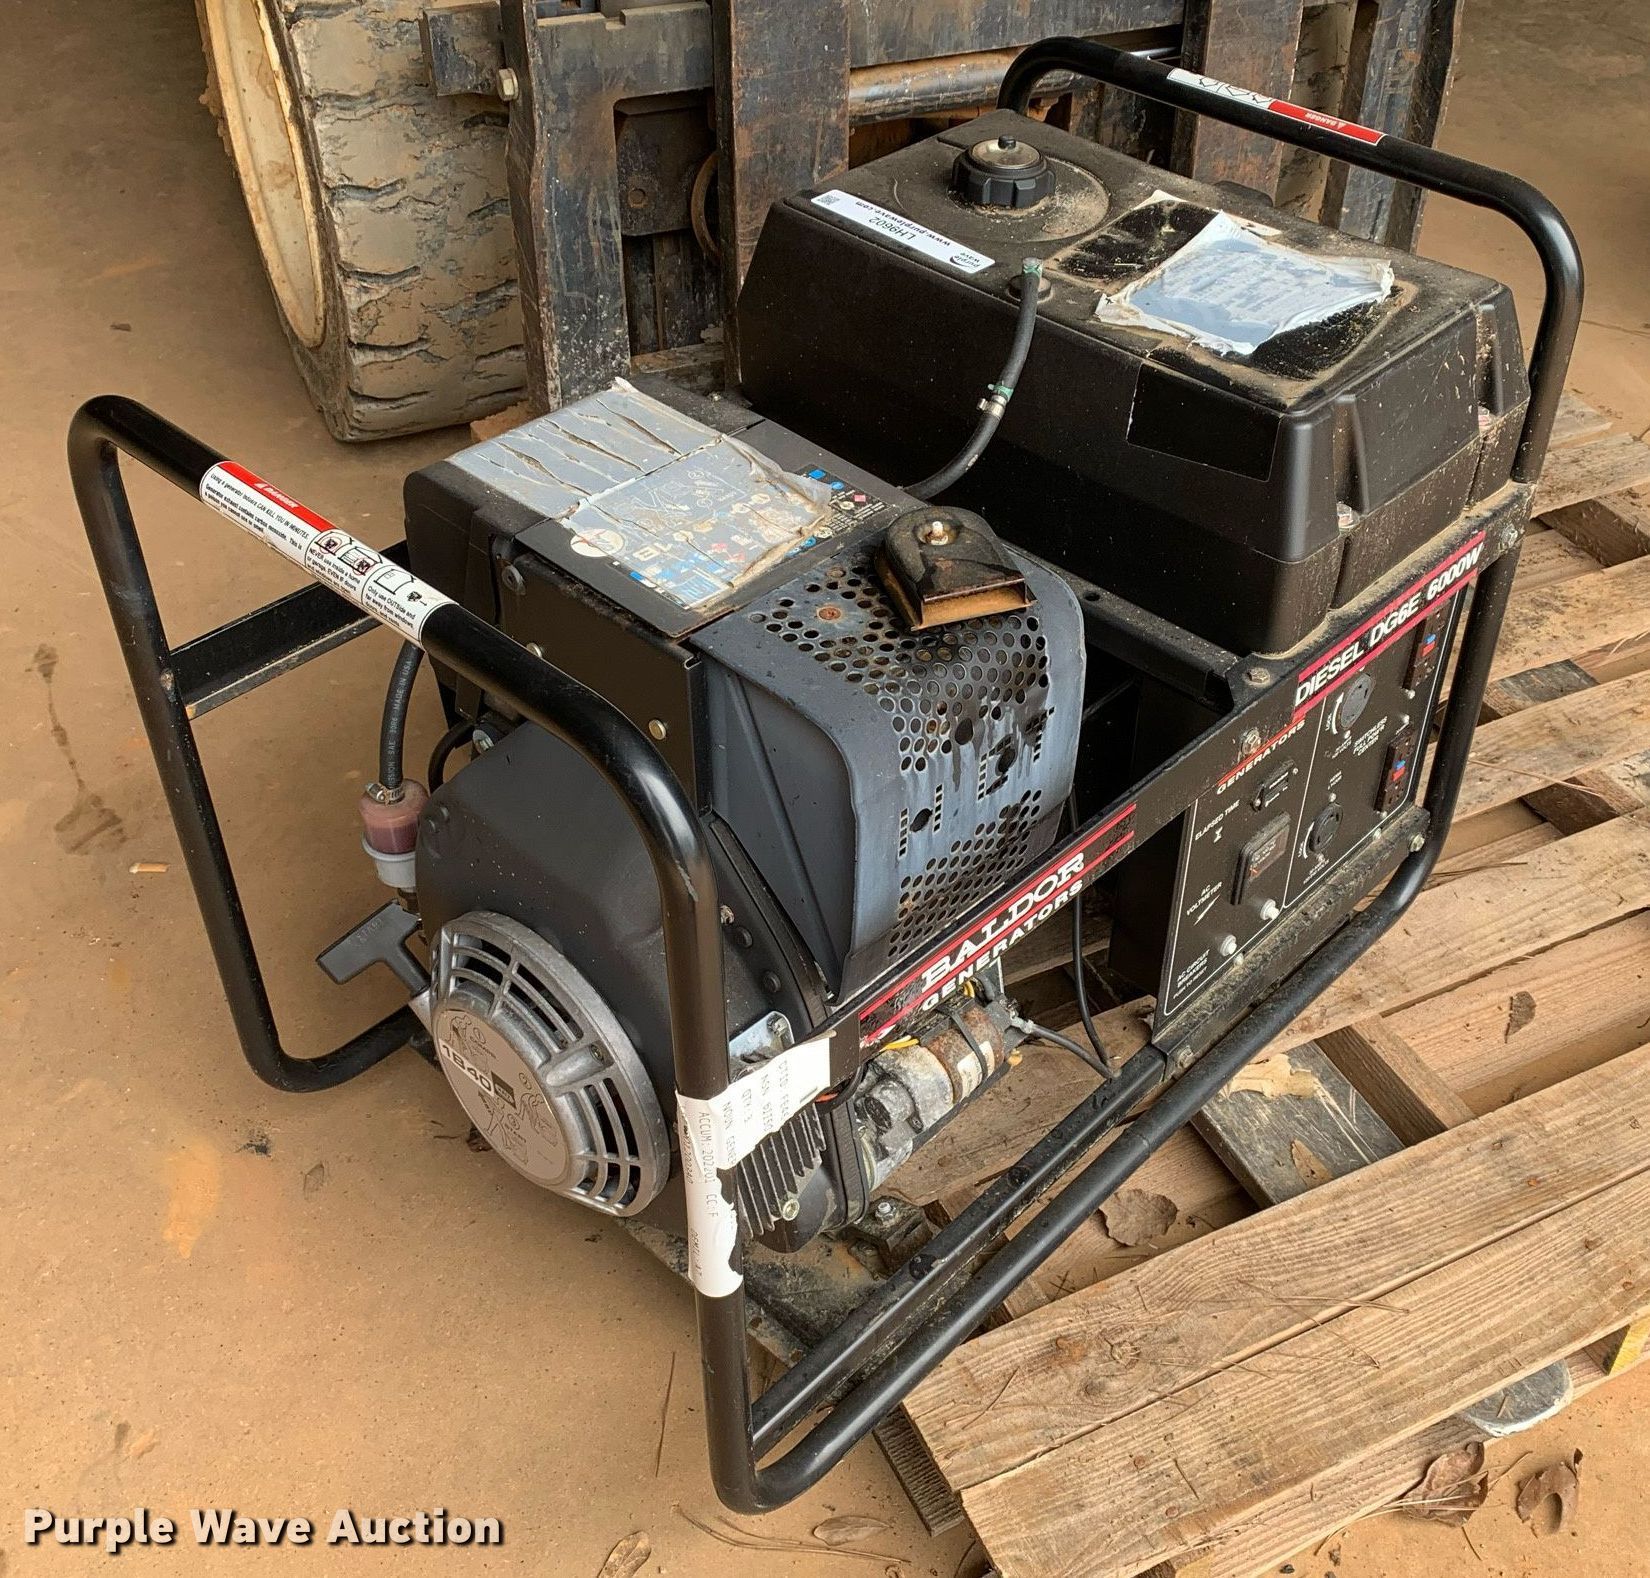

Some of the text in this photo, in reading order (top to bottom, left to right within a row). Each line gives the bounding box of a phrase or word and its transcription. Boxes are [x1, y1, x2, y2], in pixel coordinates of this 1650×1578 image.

[869, 217, 917, 241] LH9602
[256, 503, 266, 512] CAN
[275, 514, 285, 524] YOU
[1294, 643, 1365, 707] DIESEL
[1426, 542, 1484, 601] 6000W
[1216, 719, 1306, 795] GENERATORS
[1195, 799, 1240, 841] ELAPSED TIME
[922, 852, 1085, 993] BALDOR
[922, 880, 1083, 1011] GENERATORS
